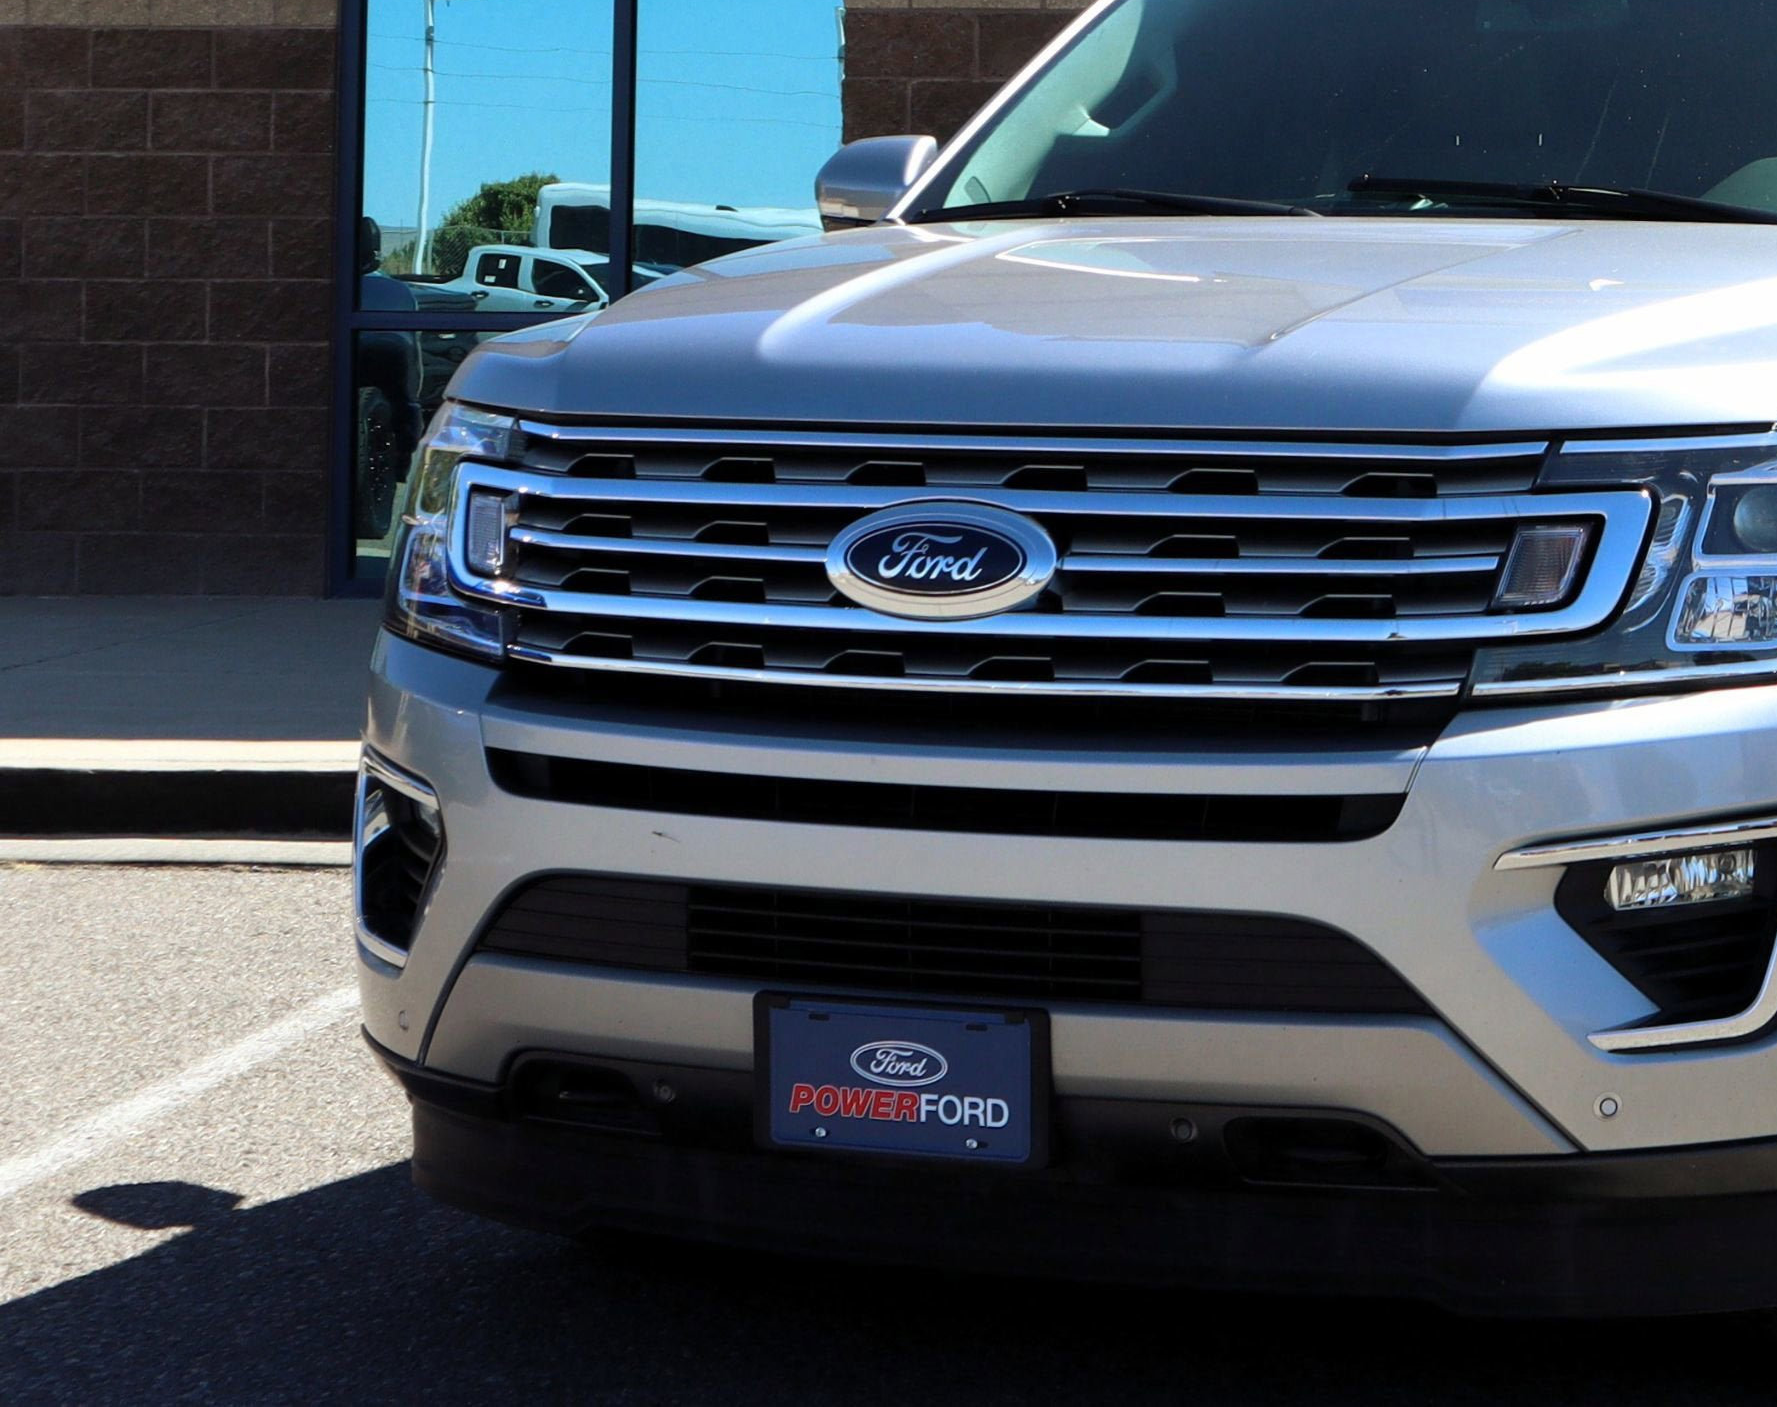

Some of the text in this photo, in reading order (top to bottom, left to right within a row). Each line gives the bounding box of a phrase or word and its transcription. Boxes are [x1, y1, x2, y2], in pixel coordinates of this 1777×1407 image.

[877, 531, 989, 582] Ford
[869, 1047, 928, 1078] Ford
[789, 1083, 1010, 1129] POWERFORD
